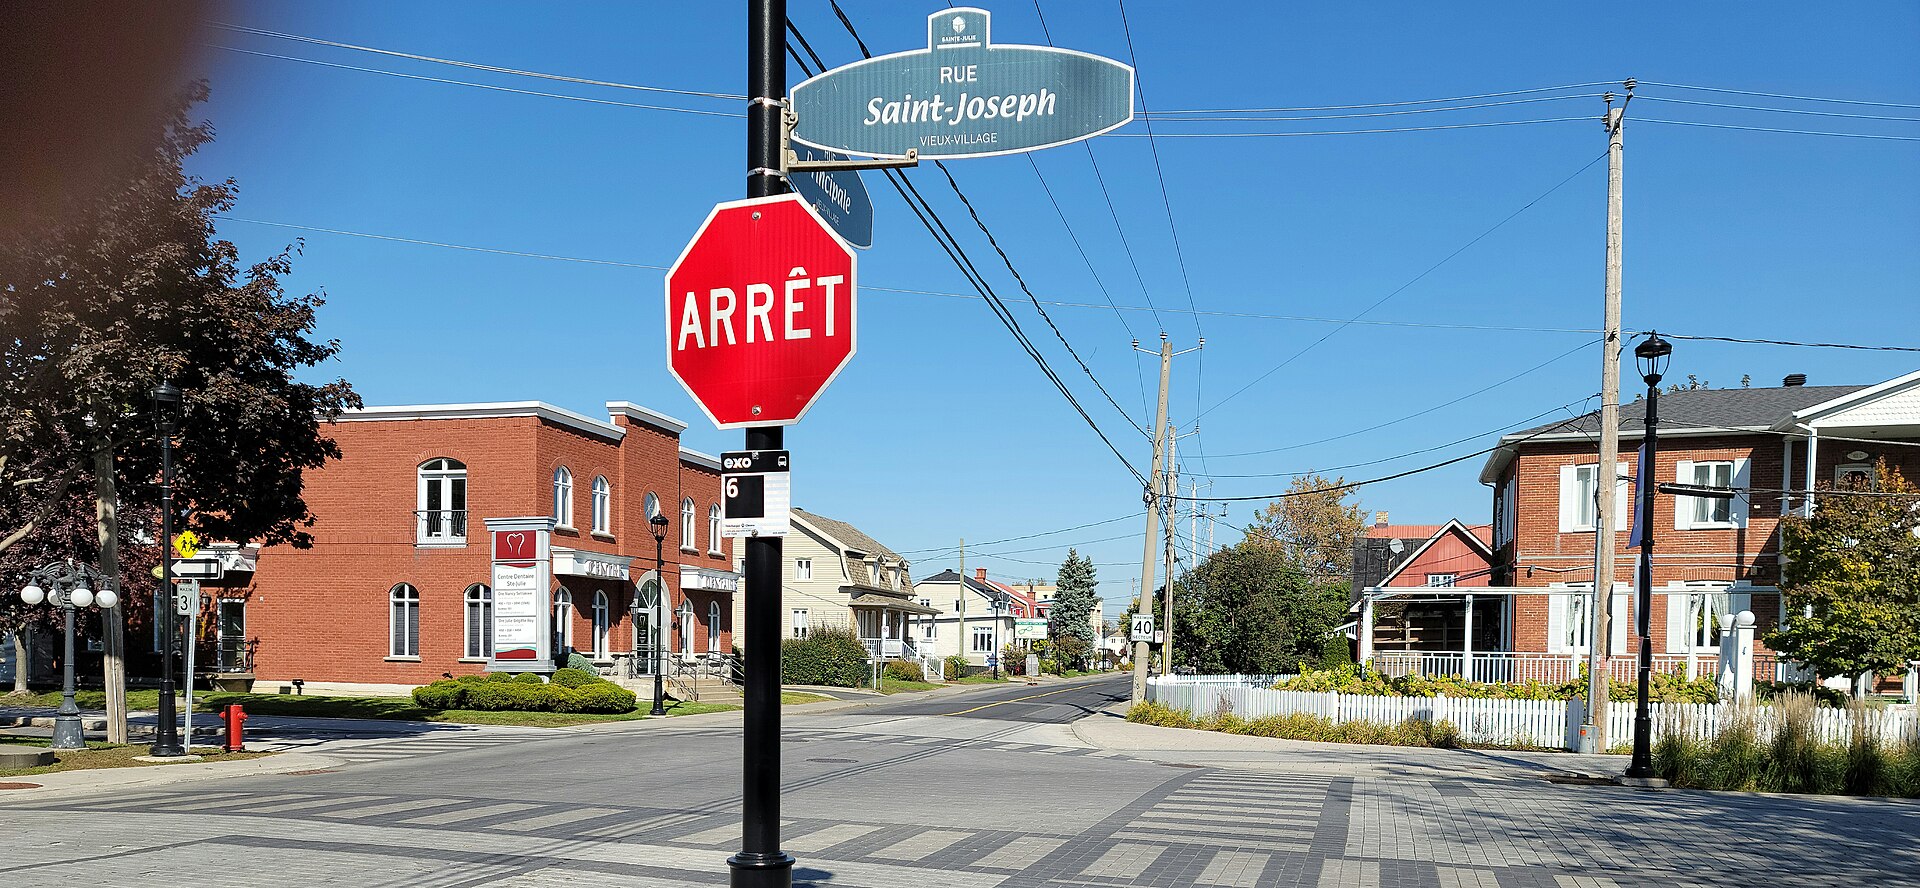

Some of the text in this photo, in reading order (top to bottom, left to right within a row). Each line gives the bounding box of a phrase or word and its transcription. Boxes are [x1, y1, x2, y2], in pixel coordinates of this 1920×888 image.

[941, 34, 977, 43] SAINTE-JULIE
[940, 65, 978, 84] RUE
[863, 87, 1057, 126] Saint-Joseph
[919, 132, 998, 147] VIEUX-VILLAGE
[677, 266, 844, 351] ARRÊT
[723, 457, 752, 469] exo
[726, 477, 739, 498] 6
[1133, 620, 1152, 634] 40
